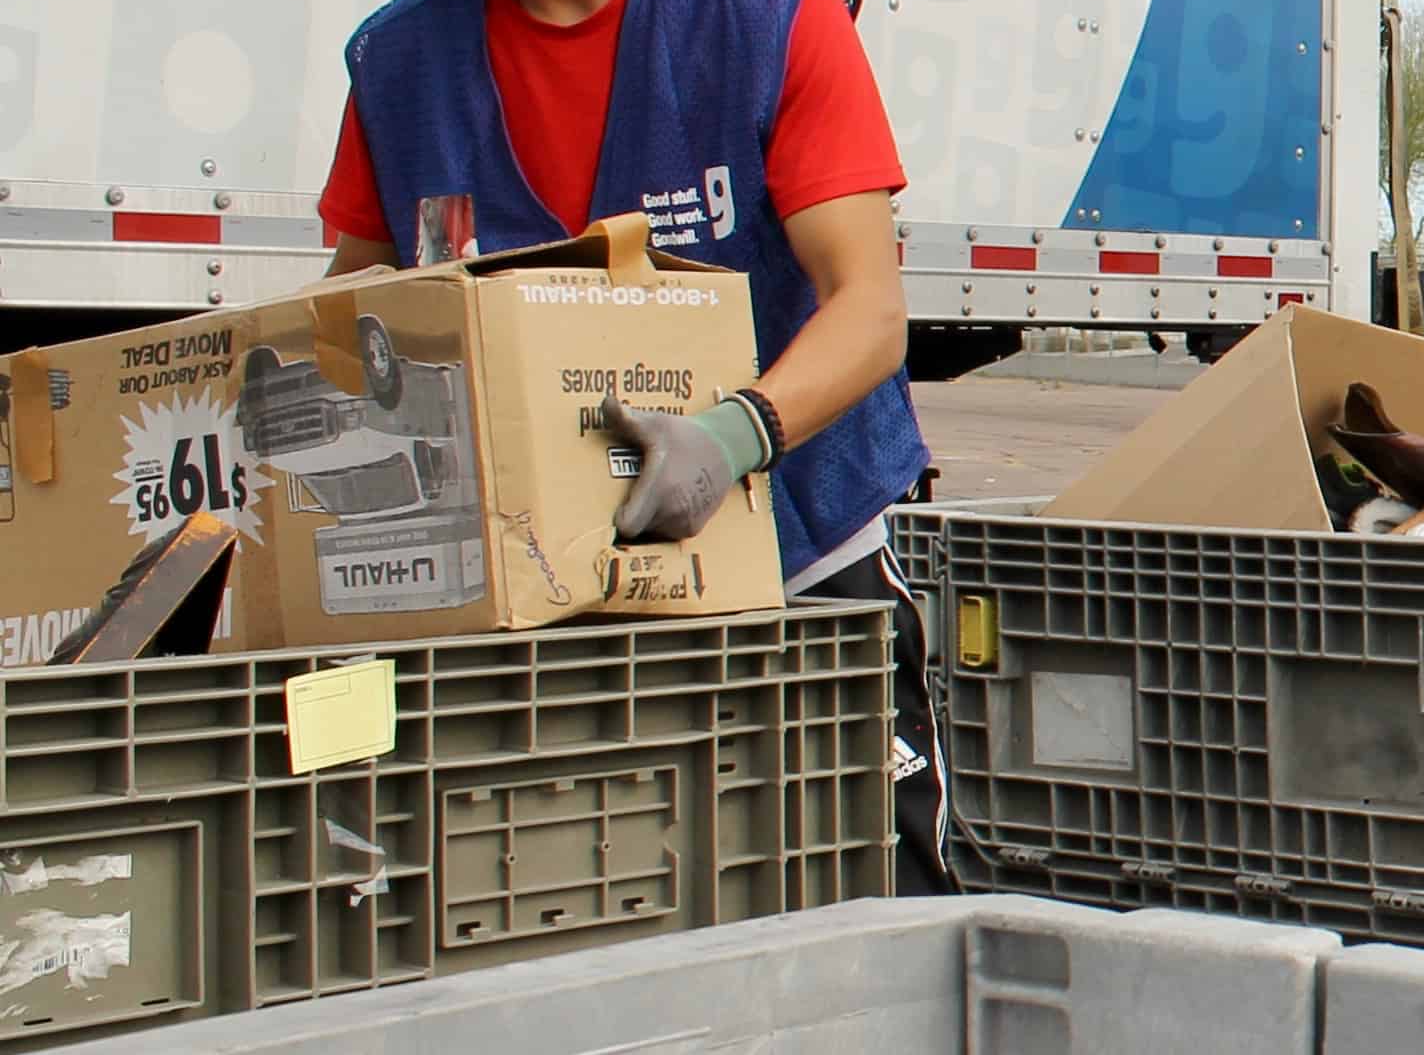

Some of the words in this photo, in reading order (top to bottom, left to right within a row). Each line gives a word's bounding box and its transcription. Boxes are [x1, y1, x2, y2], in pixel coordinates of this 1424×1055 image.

[643, 192, 670, 208] Good
[674, 208, 707, 225] work.
[516, 284, 720, 306] 1-800-GO-U-HAUL
[175, 330, 232, 357] MOVE
[152, 365, 200, 388] ABOUT
[203, 359, 233, 379] ASK
[119, 375, 149, 394] OUR
[561, 368, 617, 394] Boxes
[622, 362, 693, 400] Storage
[613, 459, 640, 474] AUL
[334, 558, 435, 588] U-HAUL
[0, 608, 90, 666] MOVE
